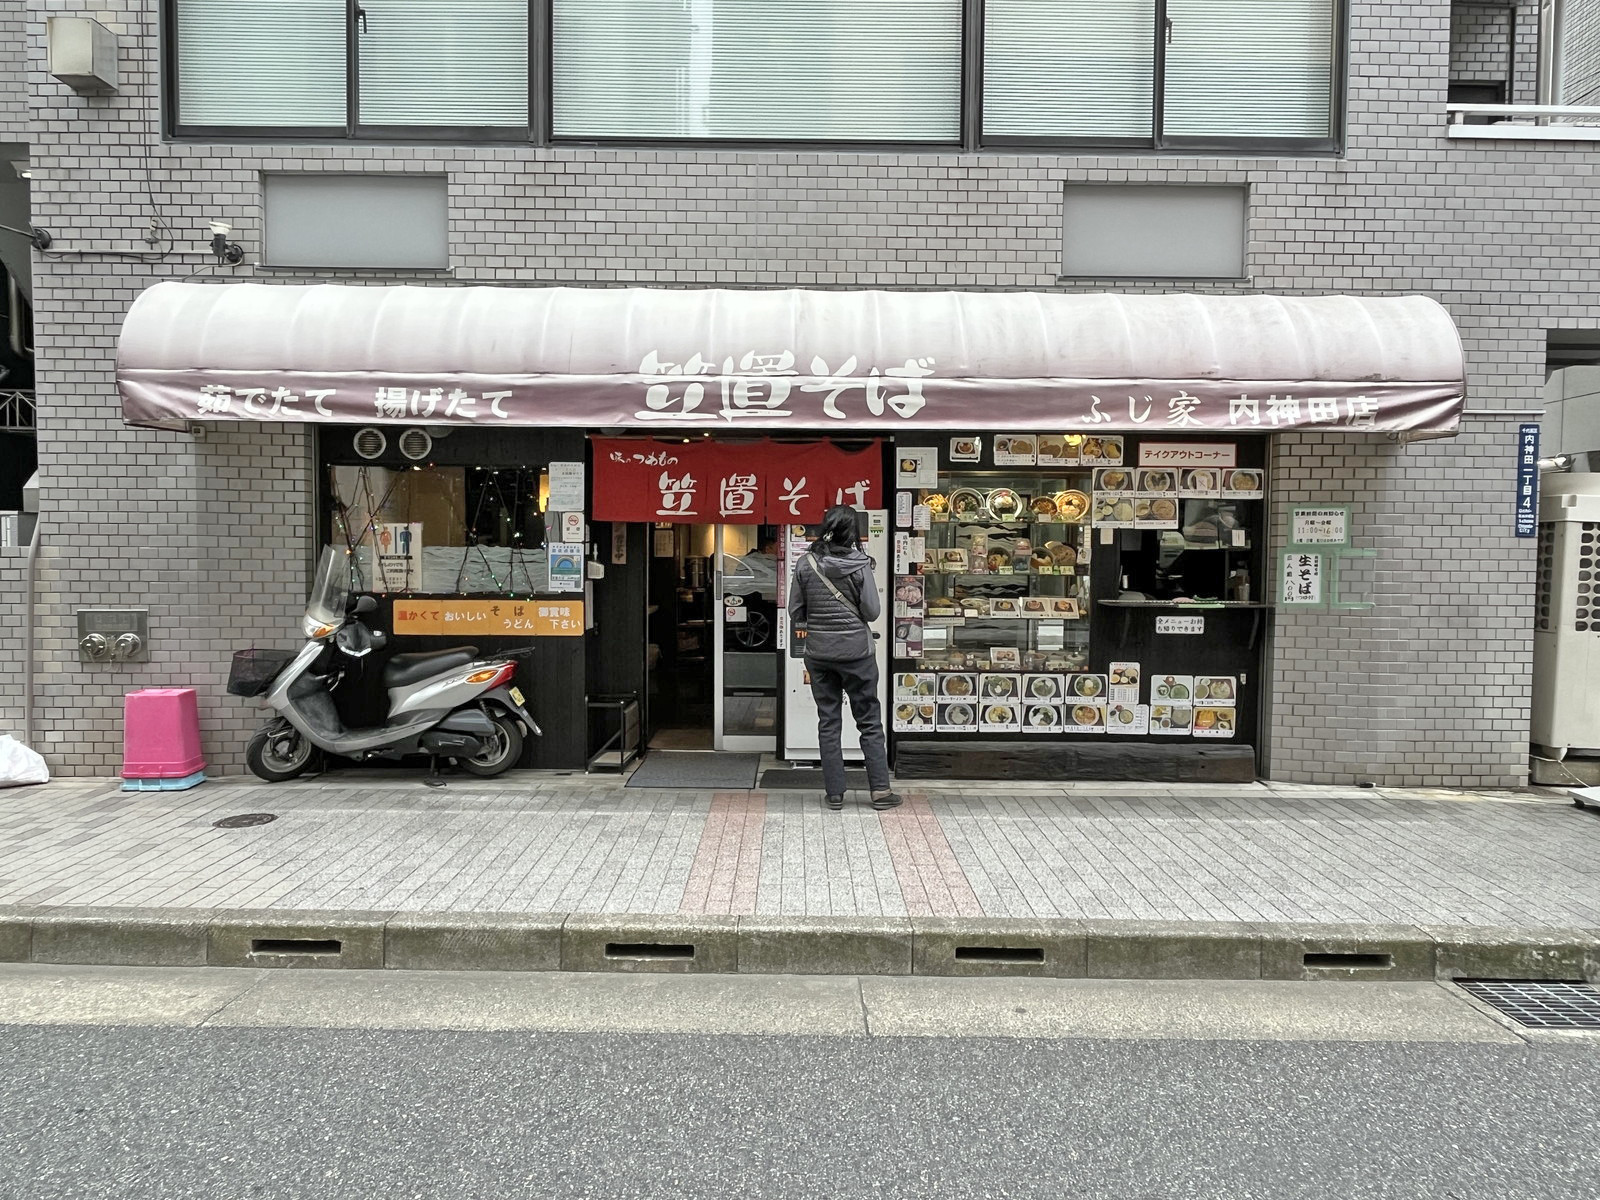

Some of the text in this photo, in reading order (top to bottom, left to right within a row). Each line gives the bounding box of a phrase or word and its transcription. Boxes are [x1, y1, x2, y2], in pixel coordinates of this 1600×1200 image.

[197, 385, 514, 418] 茹でたて 揚げたて
[634, 349, 936, 423] 笠置そば
[1081, 391, 1380, 427] ふじ家 内神田店
[1144, 449, 1231, 460] テイクアウトコーナー
[1298, 554, 1313, 595] 生そば
[397, 610, 440, 621] 温かくて
[444, 611, 487, 622] おいしい
[503, 618, 582, 630] うどん 下さい
